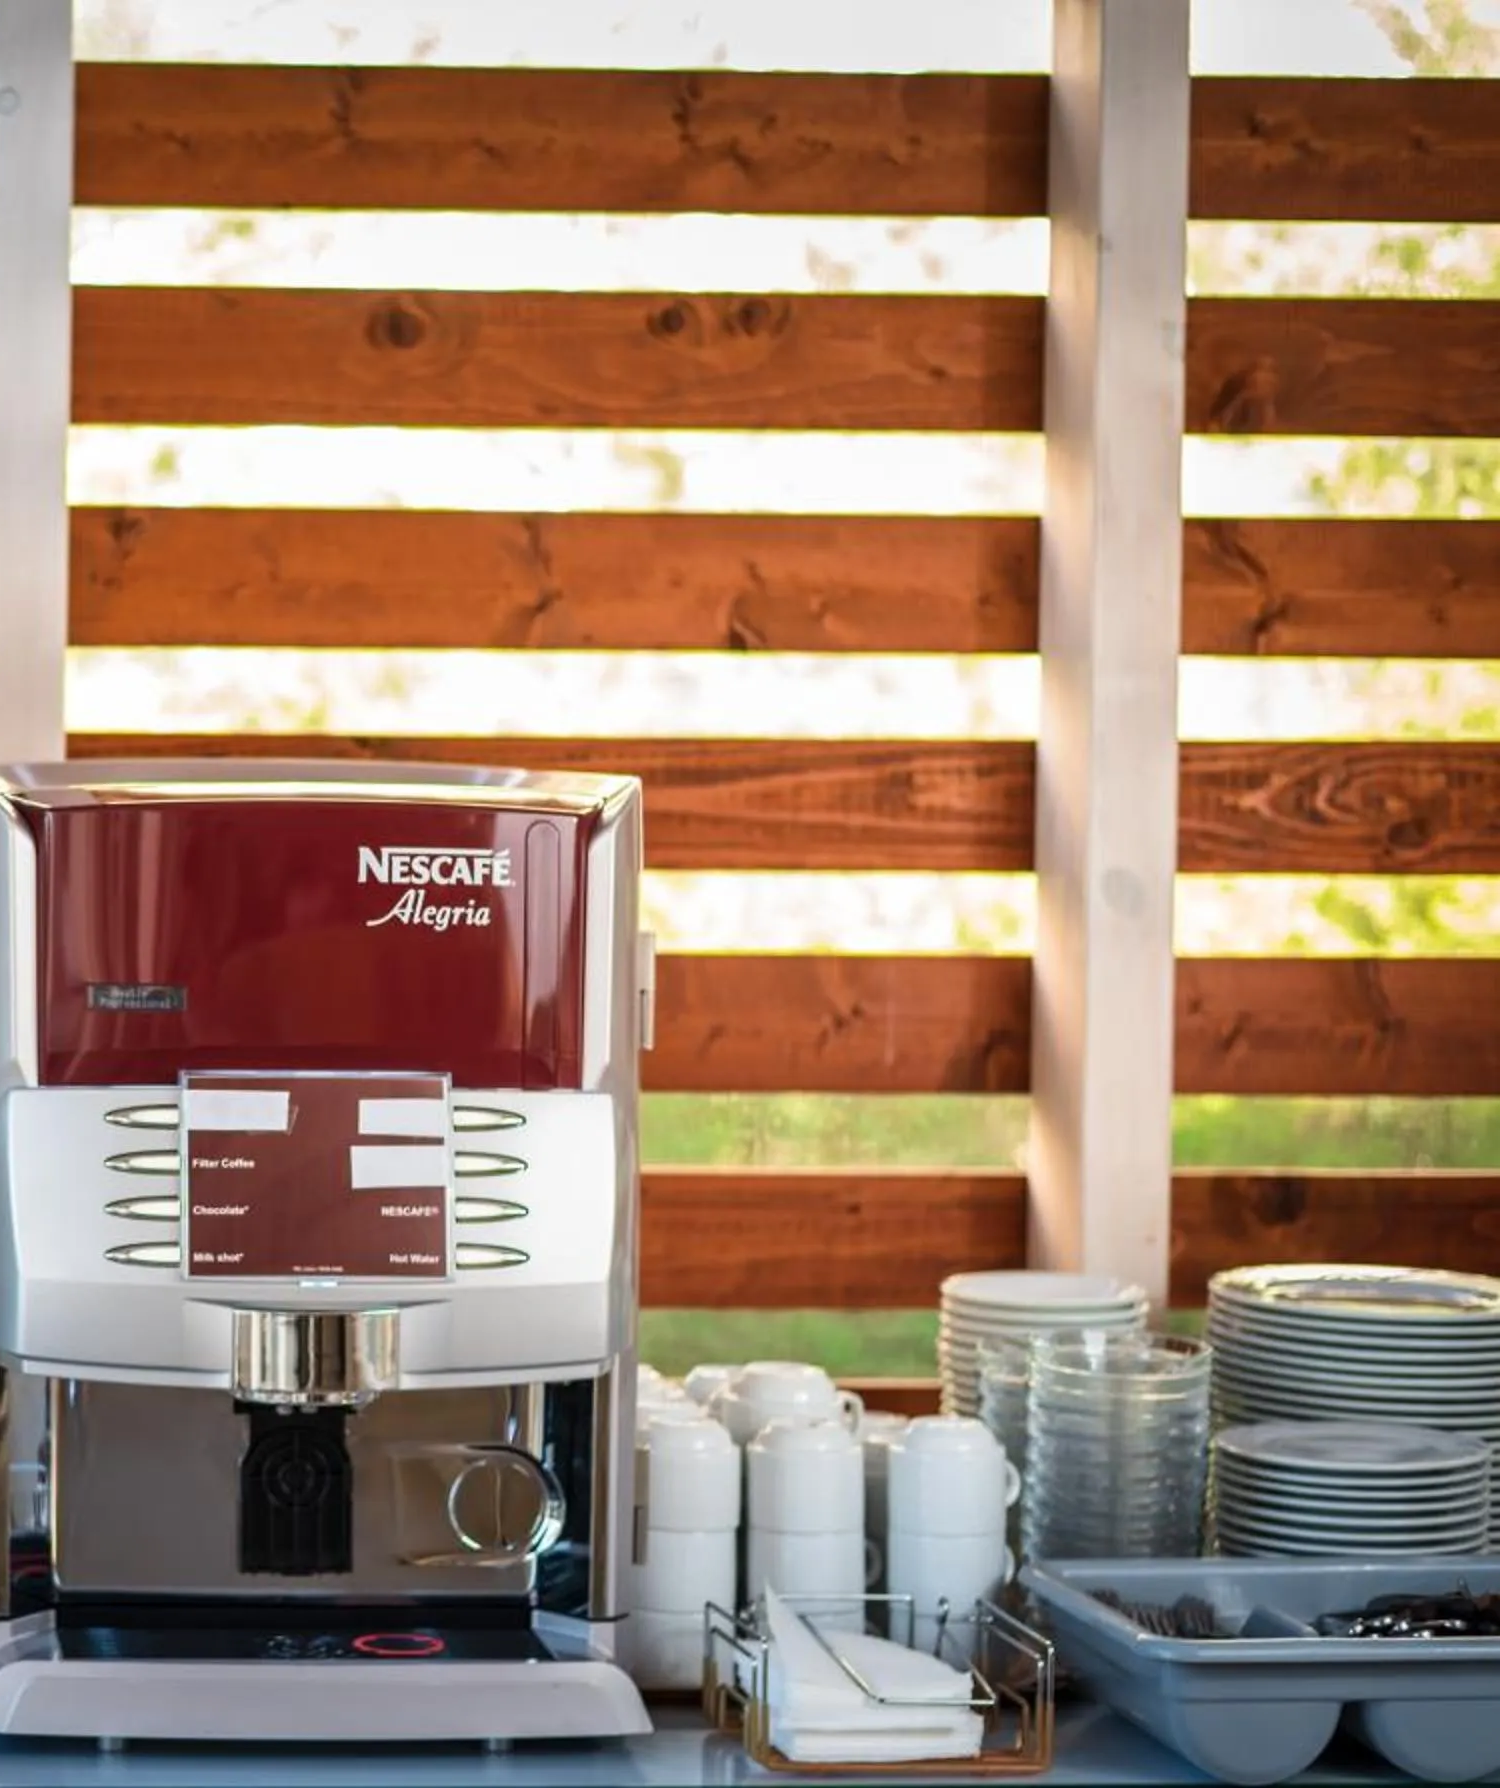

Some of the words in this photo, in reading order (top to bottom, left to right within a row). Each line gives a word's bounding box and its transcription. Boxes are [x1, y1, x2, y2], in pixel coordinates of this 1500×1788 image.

[365, 889, 492, 932] Alegria
[192, 1158, 220, 1169] Filter
[221, 1157, 255, 1169] Coffee
[192, 1251, 215, 1263] Milk
[389, 1253, 409, 1264] Hot
[409, 1253, 440, 1265] Water
